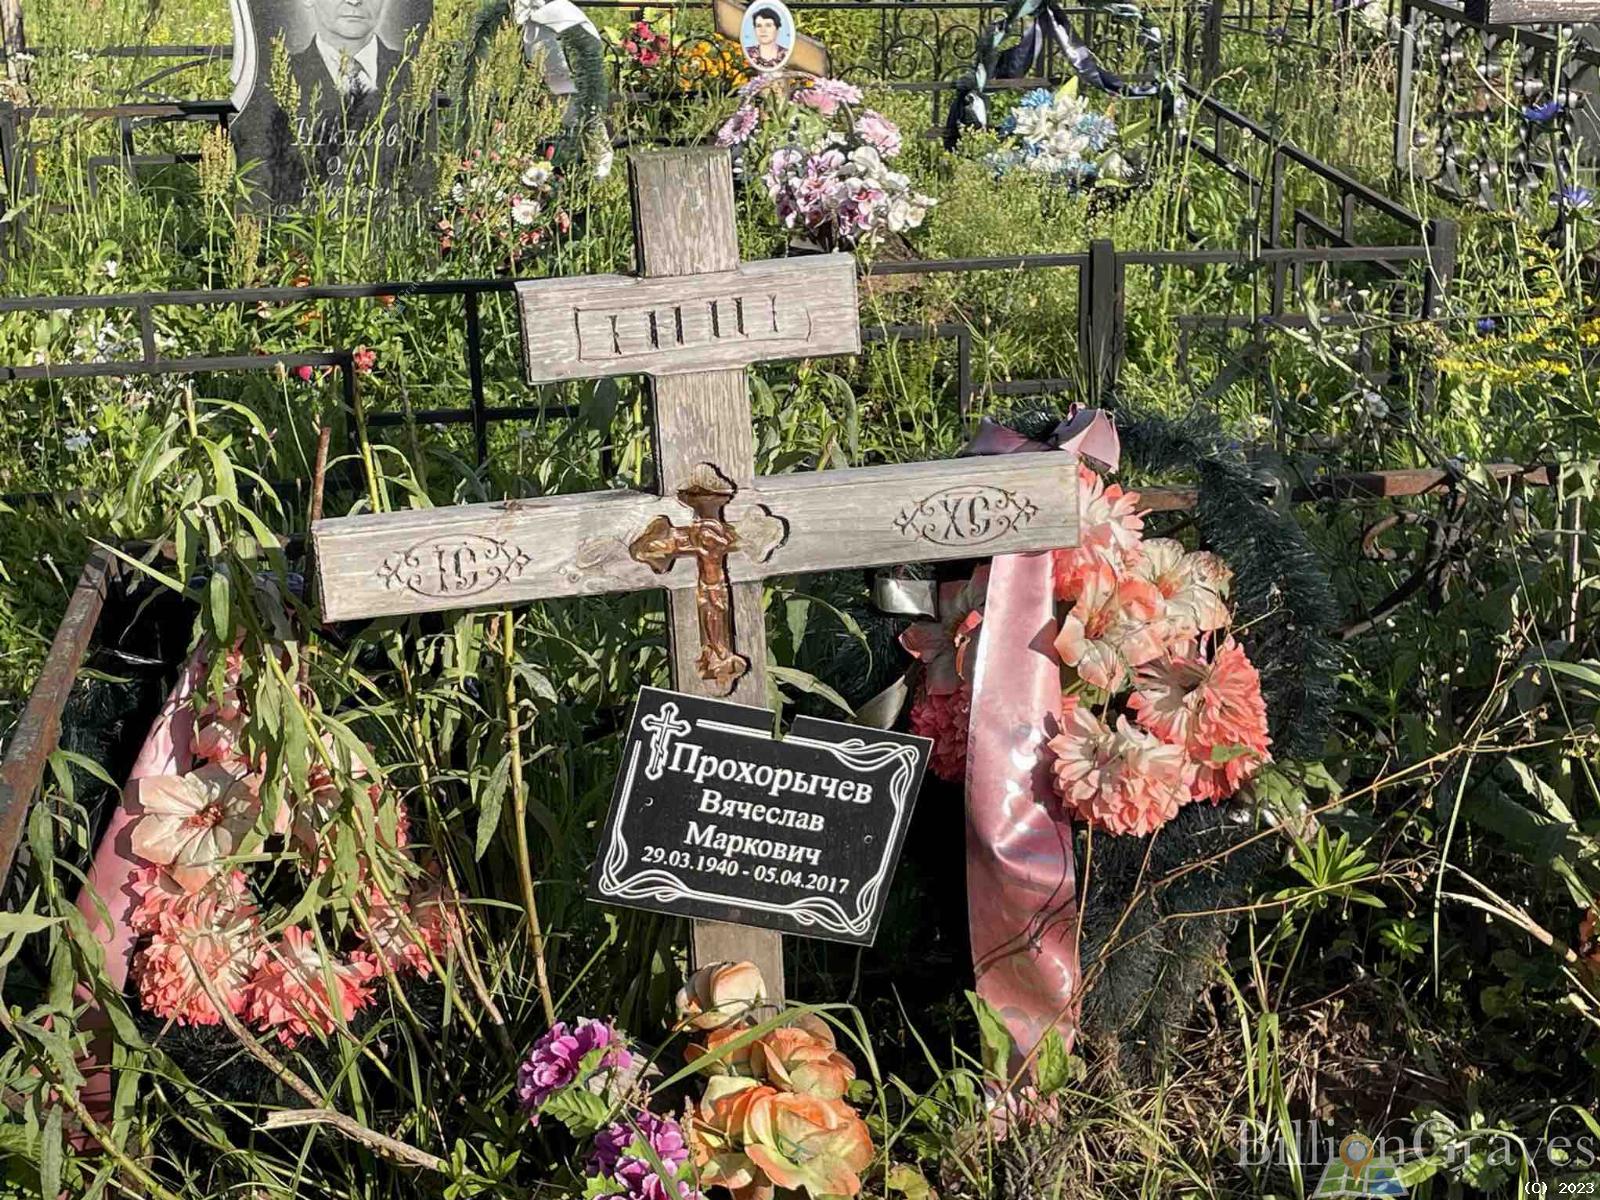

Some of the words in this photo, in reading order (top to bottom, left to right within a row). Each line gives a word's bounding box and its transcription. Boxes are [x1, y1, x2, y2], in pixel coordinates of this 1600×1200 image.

[667, 742, 874, 804] Прохорычев
[697, 788, 826, 832] Вячеслав
[683, 821, 823, 866] Маркович
[640, 846, 740, 877] 29.03.1940
[753, 865, 850, 895] 05.04.2017
